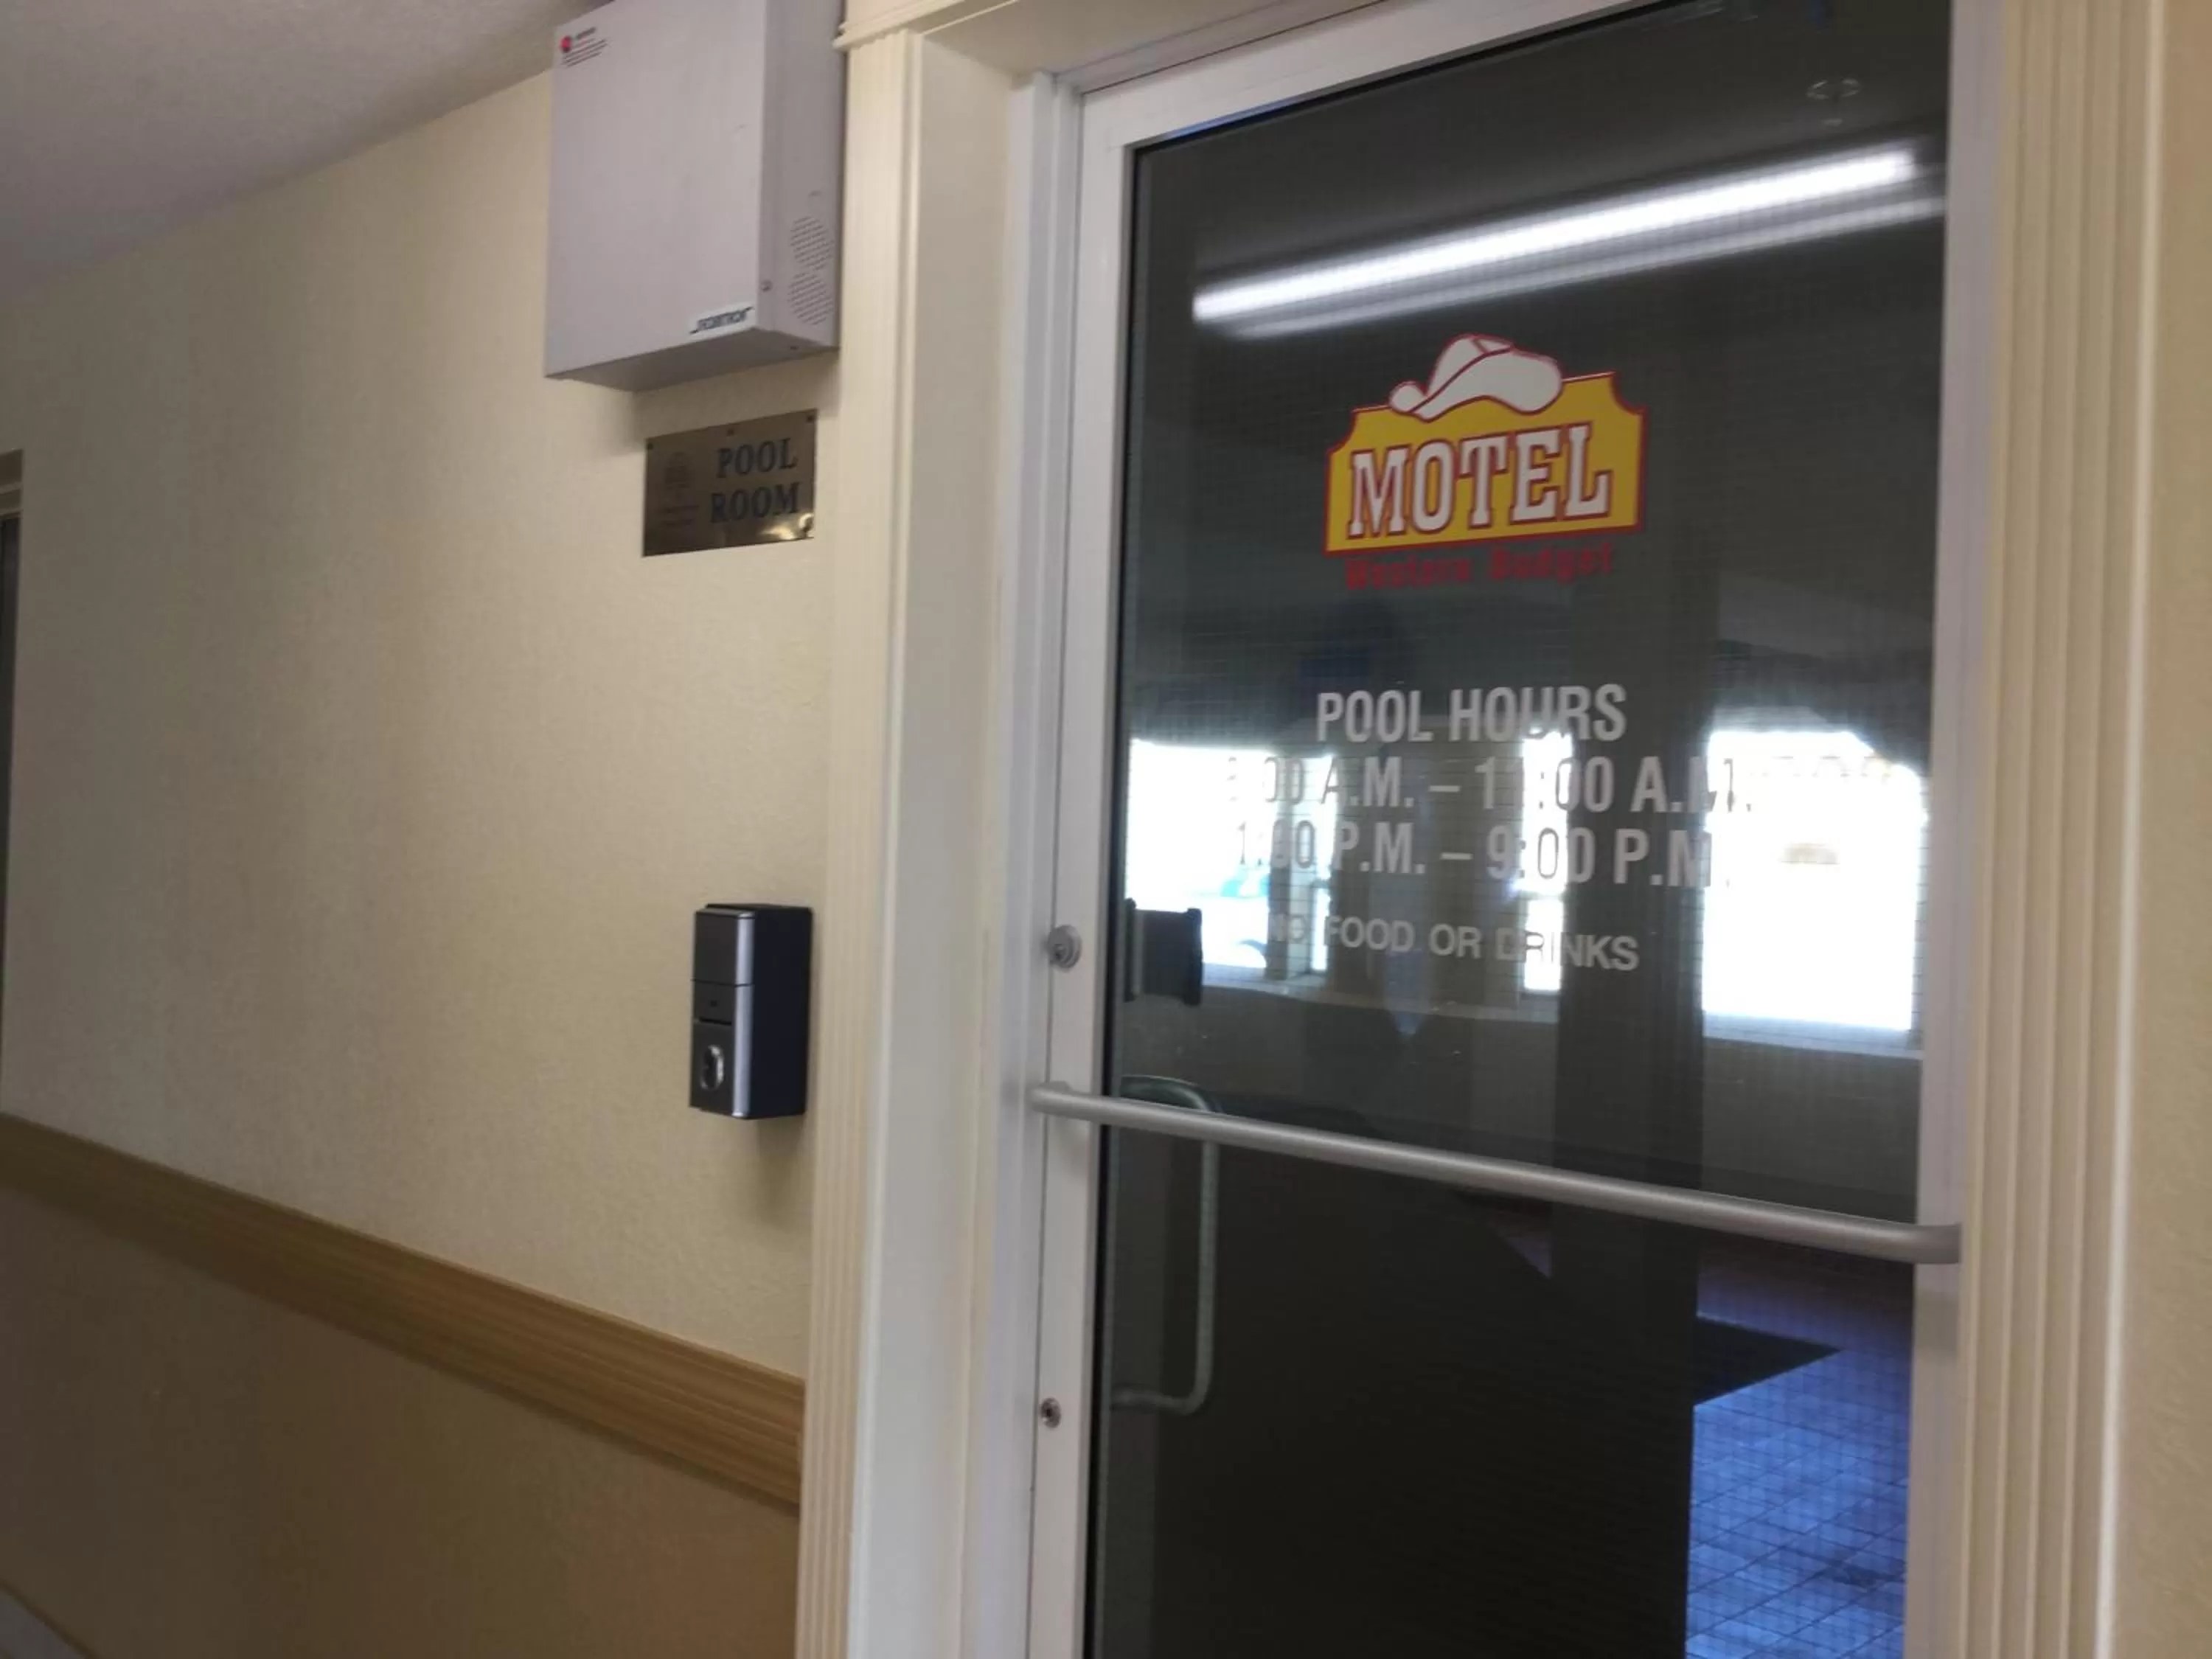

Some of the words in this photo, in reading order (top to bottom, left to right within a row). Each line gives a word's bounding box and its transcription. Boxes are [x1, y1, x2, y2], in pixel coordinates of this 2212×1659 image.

[716, 437, 799, 479] POOL
[1346, 421, 1613, 540] MOTEL
[709, 482, 801, 524] ROOM
[1489, 542, 1613, 584] Budget
[1317, 689, 1434, 742] POOL
[1448, 684, 1627, 742] HOURS
[1330, 820, 1426, 874] P.M.
[1486, 825, 1596, 884] 9:00
[1324, 914, 1415, 953] FOOD
[1428, 923, 1483, 958] OR
[1495, 926, 1641, 971] DRINKS
